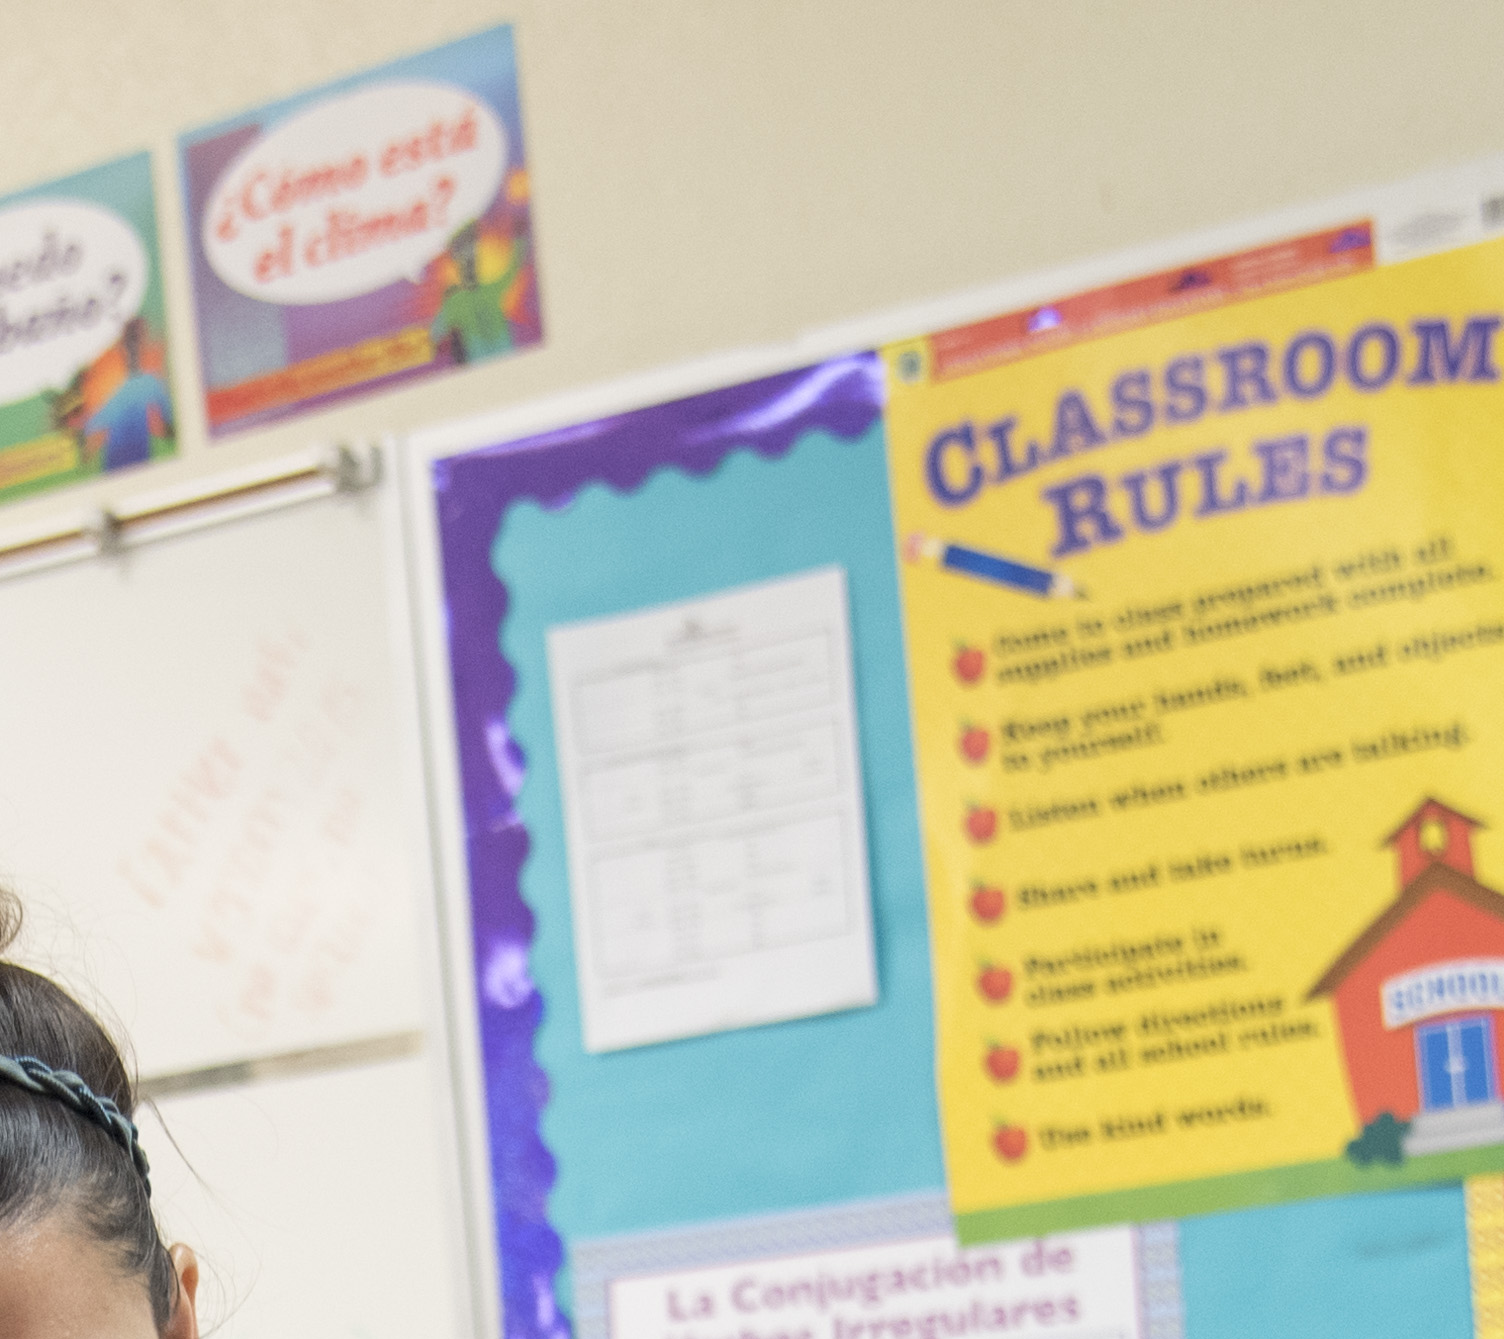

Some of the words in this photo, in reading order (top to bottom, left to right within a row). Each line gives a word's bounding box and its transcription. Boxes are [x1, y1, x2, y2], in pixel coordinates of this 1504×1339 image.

[377, 101, 480, 187] está
[252, 234, 295, 284] el
[301, 176, 456, 273] clima?
[1044, 426, 1370, 558] RULES
[1196, 566, 1323, 612] prepared
[1337, 550, 1401, 579] with
[1416, 534, 1452, 561] all
[1123, 629, 1174, 658] and
[1184, 594, 1336, 639] homework
[1080, 701, 1146, 730] your
[1334, 644, 1388, 674] and
[1299, 749, 1344, 774] are
[1019, 879, 1100, 908] Share
[1111, 867, 1158, 893] and
[1171, 852, 1232, 881] take
[1024, 937, 1182, 975] Participate
[1033, 1021, 1126, 1050] Follow
[1139, 997, 1283, 1034] directions
[1035, 1057, 1083, 1081] and
[1097, 1048, 1128, 1070] all
[1142, 1032, 1228, 1063] school
[1102, 1112, 1166, 1139] kind
[667, 1290, 714, 1322] La
[1020, 1240, 1075, 1276] de
